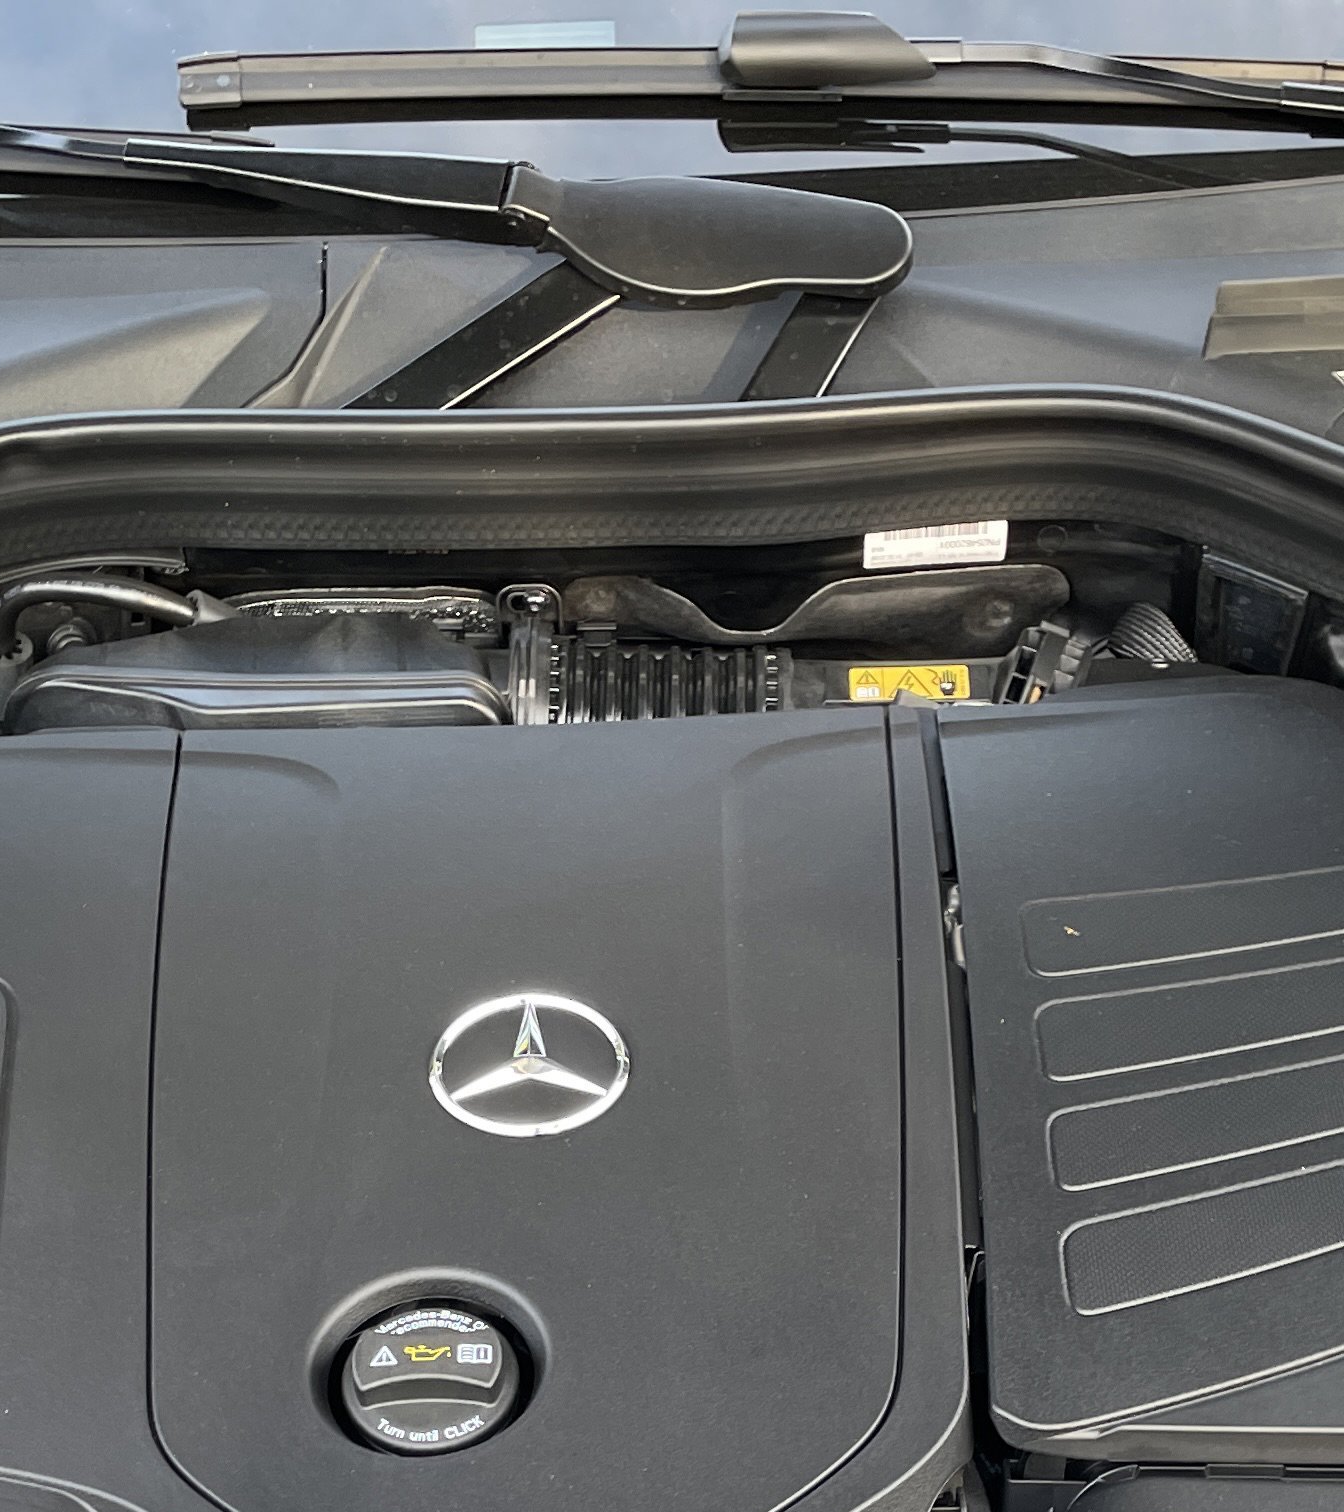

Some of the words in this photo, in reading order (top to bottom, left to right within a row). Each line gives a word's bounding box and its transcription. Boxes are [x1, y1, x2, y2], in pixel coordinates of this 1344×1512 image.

[376, 1417, 406, 1439] Turn
[409, 1429, 439, 1442] until
[444, 1415, 485, 1439] CLICK
